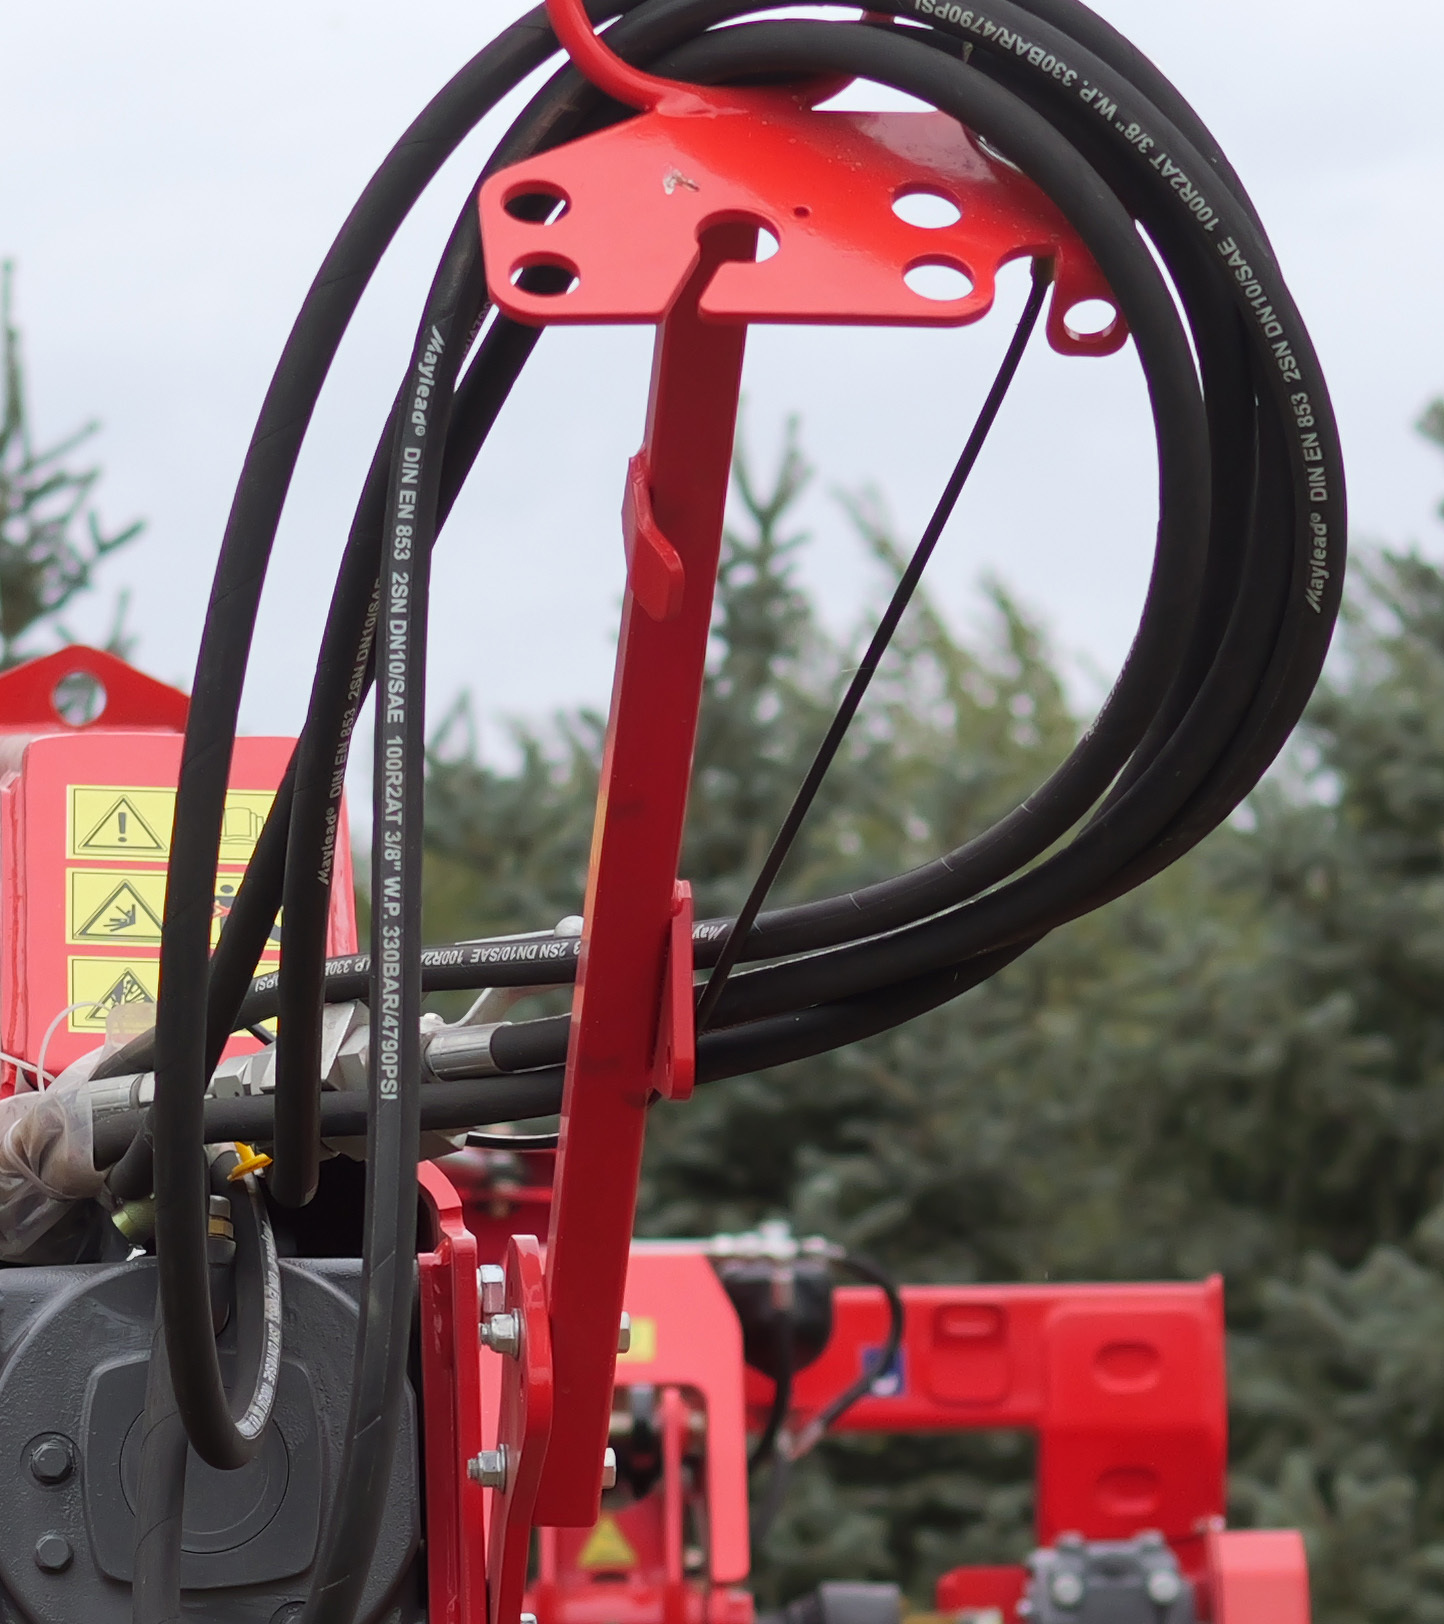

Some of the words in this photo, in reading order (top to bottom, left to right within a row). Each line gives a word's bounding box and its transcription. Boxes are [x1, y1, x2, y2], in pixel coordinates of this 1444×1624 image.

[1079, 80, 1118, 121] W.P.
[1149, 153, 1219, 232] 100R2AT
[1217, 236, 1283, 339] DN10/SAE
[1271, 340, 1301, 383] 2SN
[1291, 392, 1314, 428] 853
[401, 447, 422, 484] DIN
[1301, 432, 1323, 462] EN
[1307, 467, 1328, 502] DIN
[397, 490, 417, 519] EN
[393, 525, 413, 561] 853
[390, 572, 409, 614] 2SN
[386, 620, 408, 724] DN10/SAE
[385, 735, 404, 826] 100R2AT
[383, 876, 402, 919] W.P.
[420, 949, 464, 966] 100R2
[469, 943, 537, 965] DN10/SAE
[540, 941, 567, 959] 2SN
[380, 925, 401, 1100] 330BAR/4790PSI
